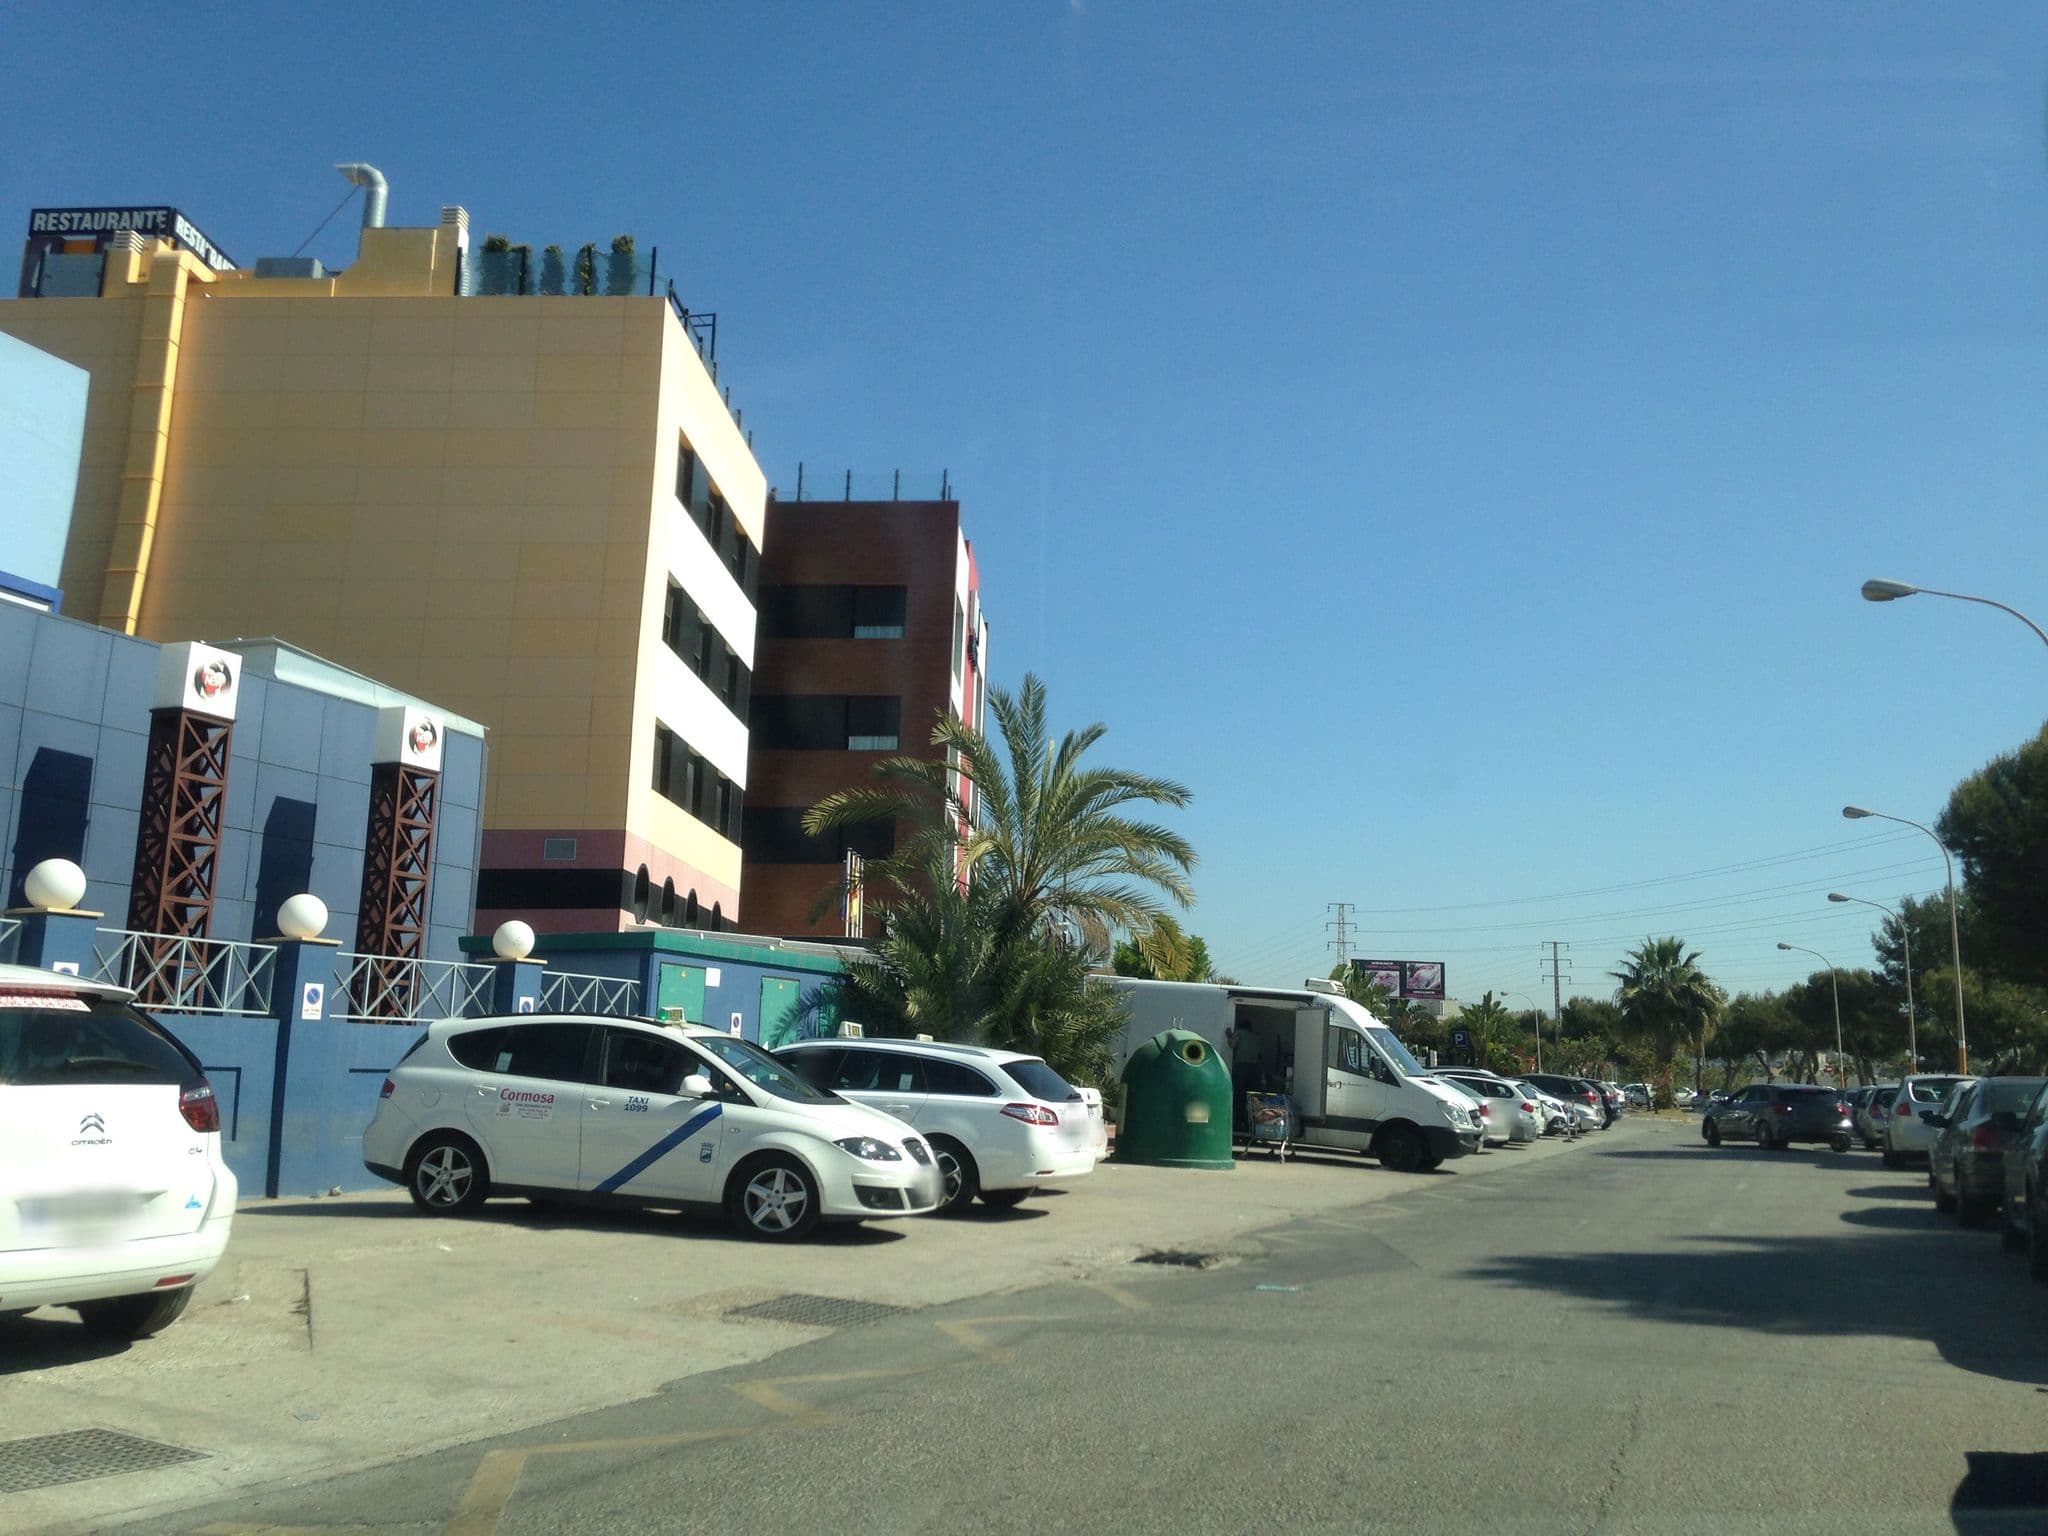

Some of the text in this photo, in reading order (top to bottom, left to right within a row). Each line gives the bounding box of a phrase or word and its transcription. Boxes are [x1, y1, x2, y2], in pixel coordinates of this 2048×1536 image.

[32, 210, 168, 231] RESTAURANTE
[1455, 1033, 1464, 1045] P
[500, 1087, 555, 1104] Cormosa
[628, 1095, 650, 1105] TAXI
[623, 1103, 649, 1113] 1099
